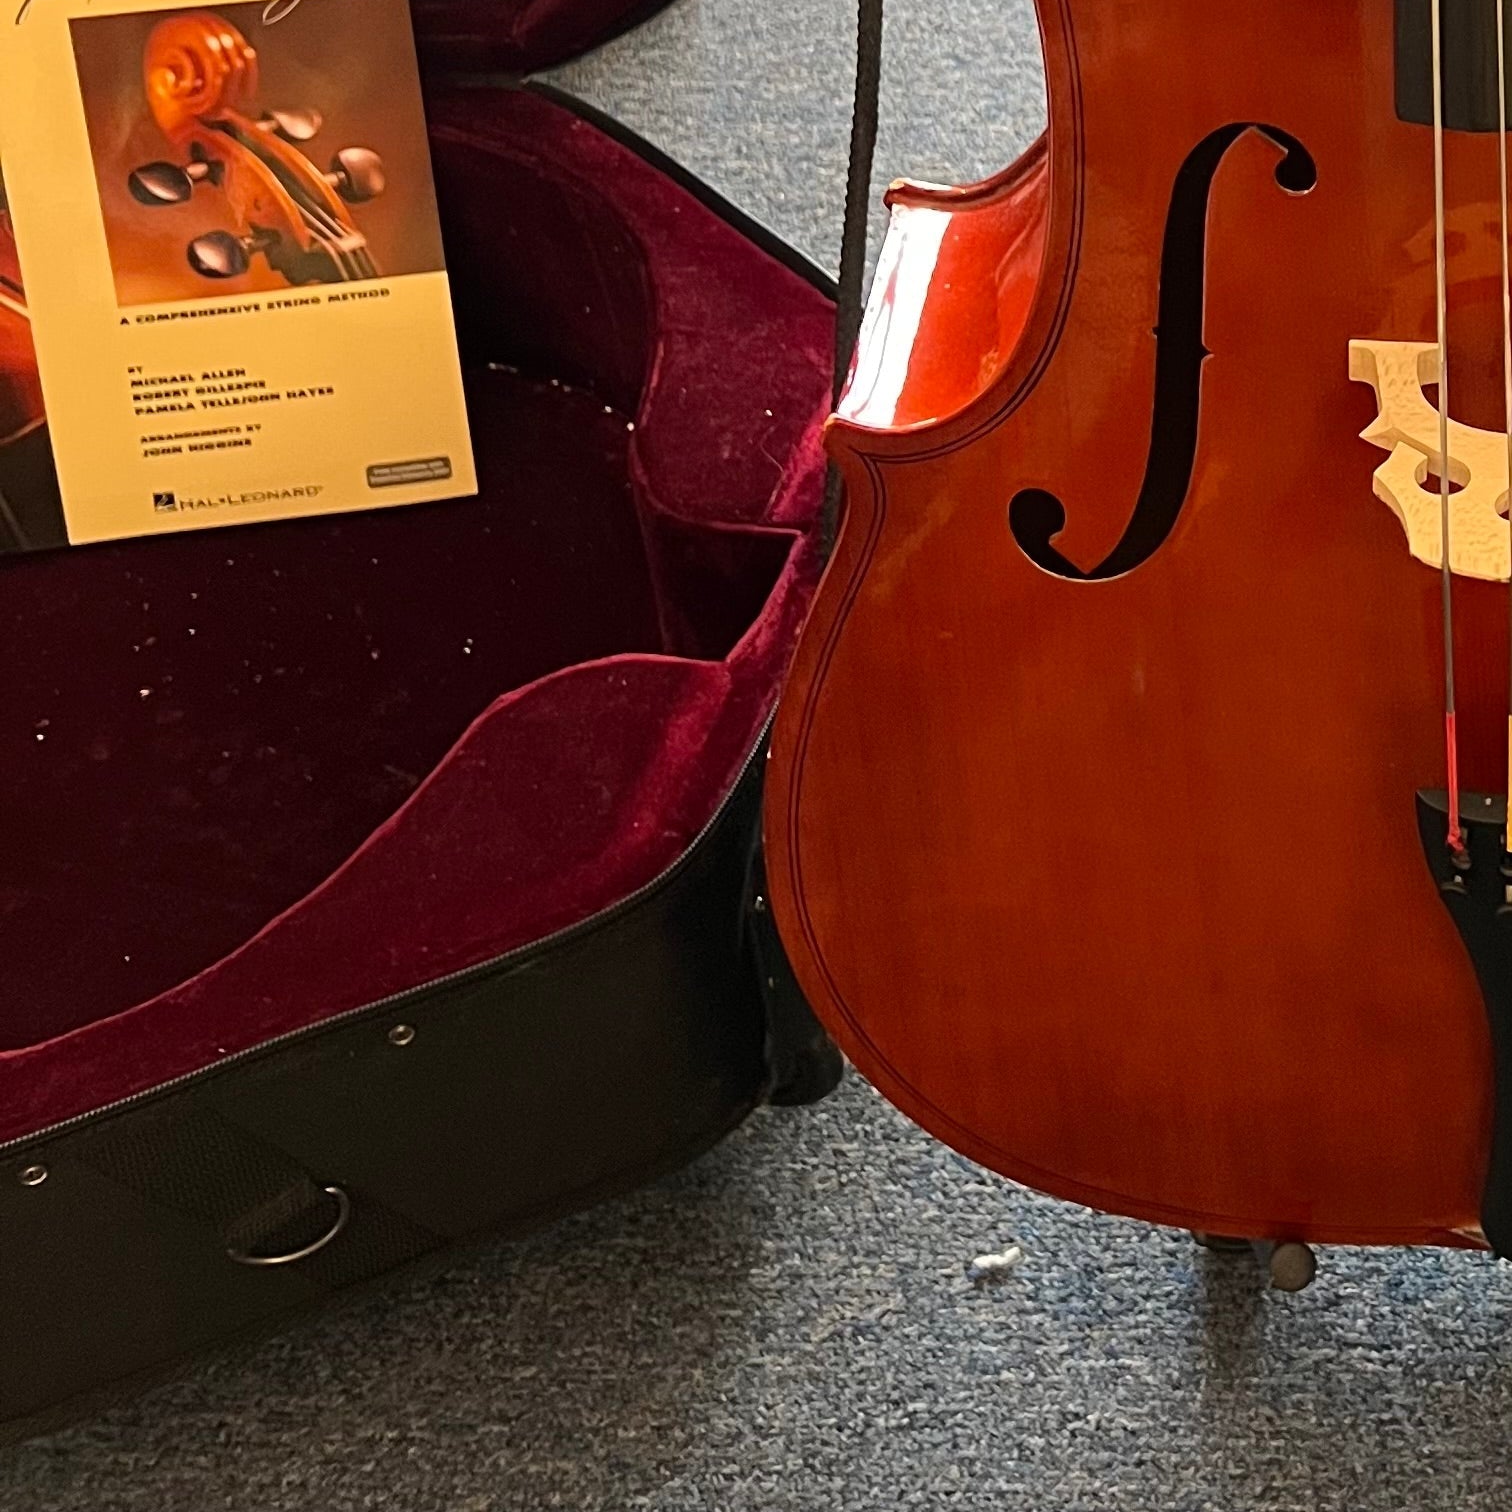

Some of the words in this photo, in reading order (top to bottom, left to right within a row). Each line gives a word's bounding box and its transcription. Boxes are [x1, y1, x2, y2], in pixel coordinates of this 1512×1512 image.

[120, 315, 130, 326] A
[130, 373, 195, 388] MICHAEL
[202, 368, 246, 381] ALLEN
[132, 388, 189, 401] ROBERT
[134, 402, 196, 416] PAMELA
[143, 446, 183, 458] JOHN
[188, 439, 252, 452] HIGGINS
